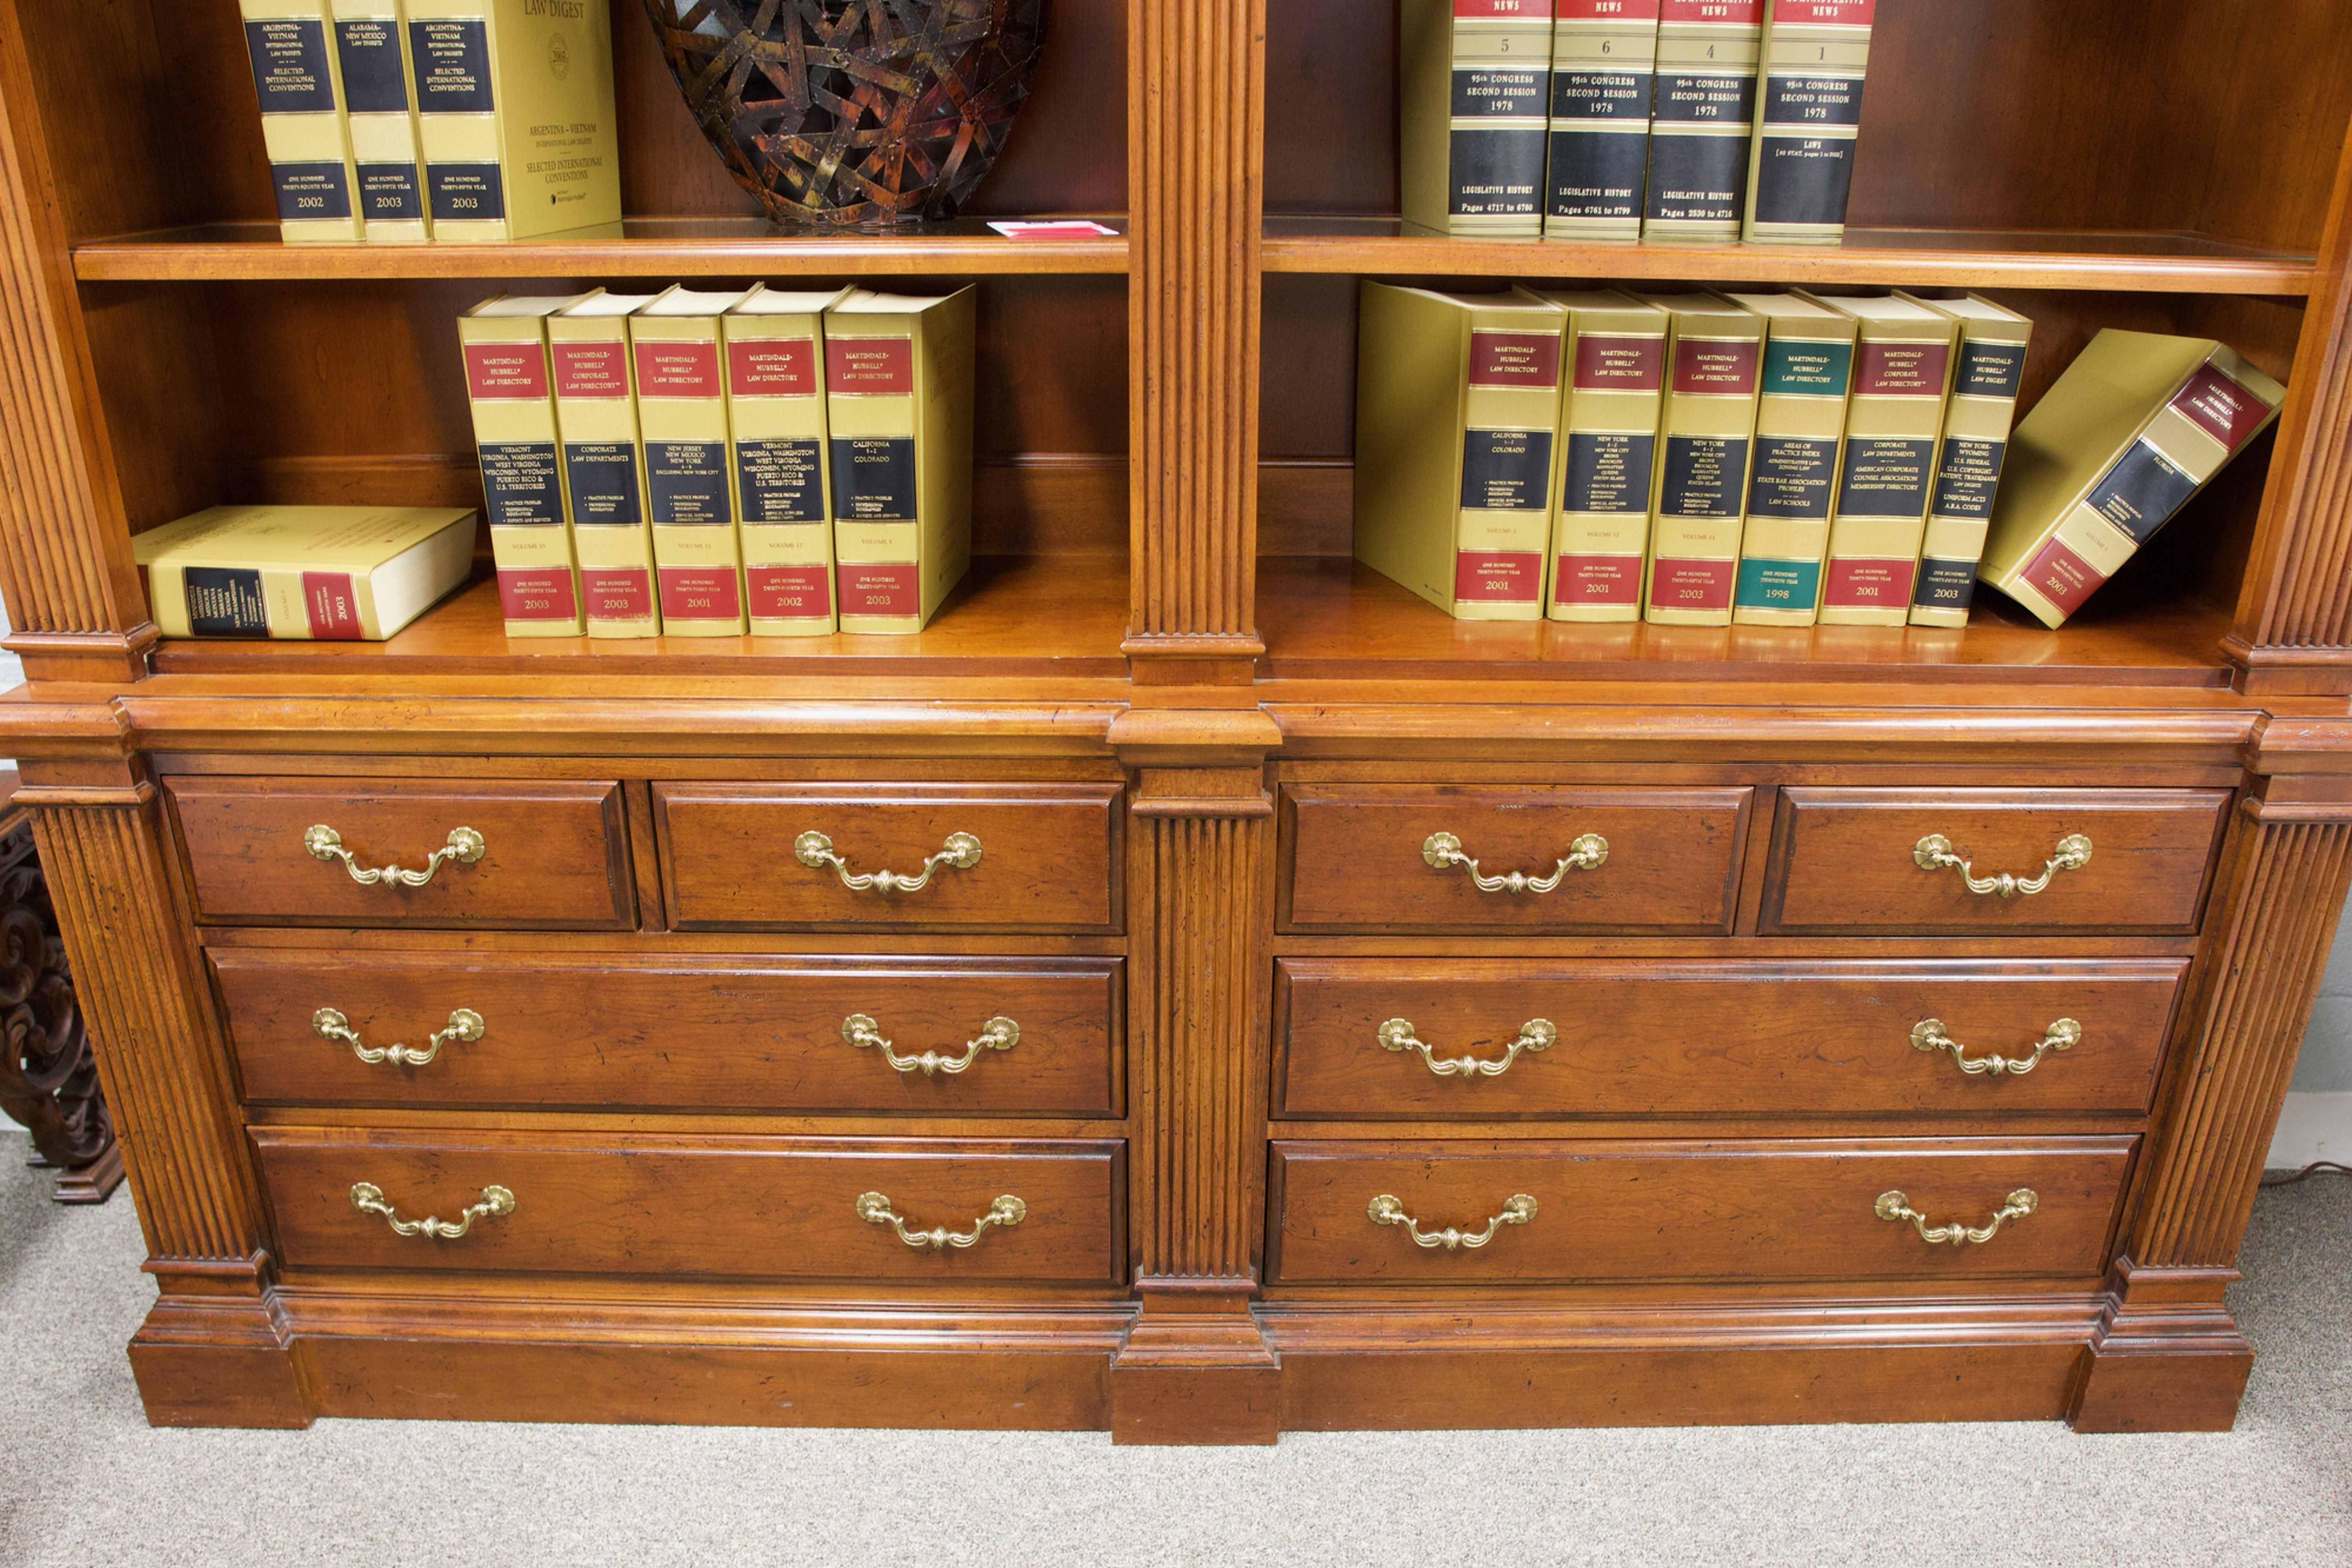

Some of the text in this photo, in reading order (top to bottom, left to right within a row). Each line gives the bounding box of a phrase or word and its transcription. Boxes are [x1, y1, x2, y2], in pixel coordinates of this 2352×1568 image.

[550, 2, 584, 19] DIGEST
[1494, 2, 1519, 10] NEWS
[1596, 2, 1621, 13] NEWS
[1702, 6, 1727, 16] NEWS
[1813, 6, 1838, 16] NEWS
[1501, 39, 1508, 52] 5
[1602, 40, 1610, 54] 6
[1706, 45, 1715, 58] 4
[1818, 47, 1824, 60] 1
[1591, 76, 1635, 85] CONGRESS
[1696, 80, 1738, 89] CONGRESS
[1806, 82, 1847, 91] CONGRESS
[1566, 89, 1637, 98] SECOND SESSION
[1671, 92, 1740, 102] SECOND SESSION
[1781, 94, 1849, 103] SECOND SESSION
[1491, 101, 1513, 111] 1978
[1590, 103, 1613, 112] 1978
[1695, 106, 1717, 116] 1978
[1804, 108, 1826, 118] 1978
[530, 123, 596, 136] ARGENTINA VIETNAM
[1804, 141, 1821, 149] LAWS
[526, 157, 602, 172] SELECTED INTERNATIONAL
[545, 171, 588, 184] CONVENTIONS
[1559, 187, 1632, 197] LEGISLATIVE HISTORY
[1663, 191, 1734, 200] LEGISLATIVE HISTORY
[298, 198, 323, 208] 2002
[376, 198, 402, 208] 2003
[452, 198, 478, 208] 2003
[1462, 203, 1483, 212] Pages
[1559, 205, 1581, 214] Pages
[1661, 209, 1684, 218] Pages
[2192, 397, 2232, 430] LAW DIRECTORY
[2153, 456, 2174, 475] FLORIDA
[1486, 581, 1508, 590] 2001
[1586, 584, 1609, 593] 2001
[2046, 577, 2067, 595] 2003
[1679, 590, 1703, 599] 2003
[1766, 590, 1789, 599] 1998
[1857, 587, 1878, 596] 2001
[1934, 589, 1958, 598] 2003
[525, 600, 550, 609] 2003
[604, 600, 628, 609] 2003
[688, 599, 711, 607] 2001
[777, 597, 802, 607] 2002
[866, 596, 891, 605] 2003
[336, 596, 347, 620] 2003
